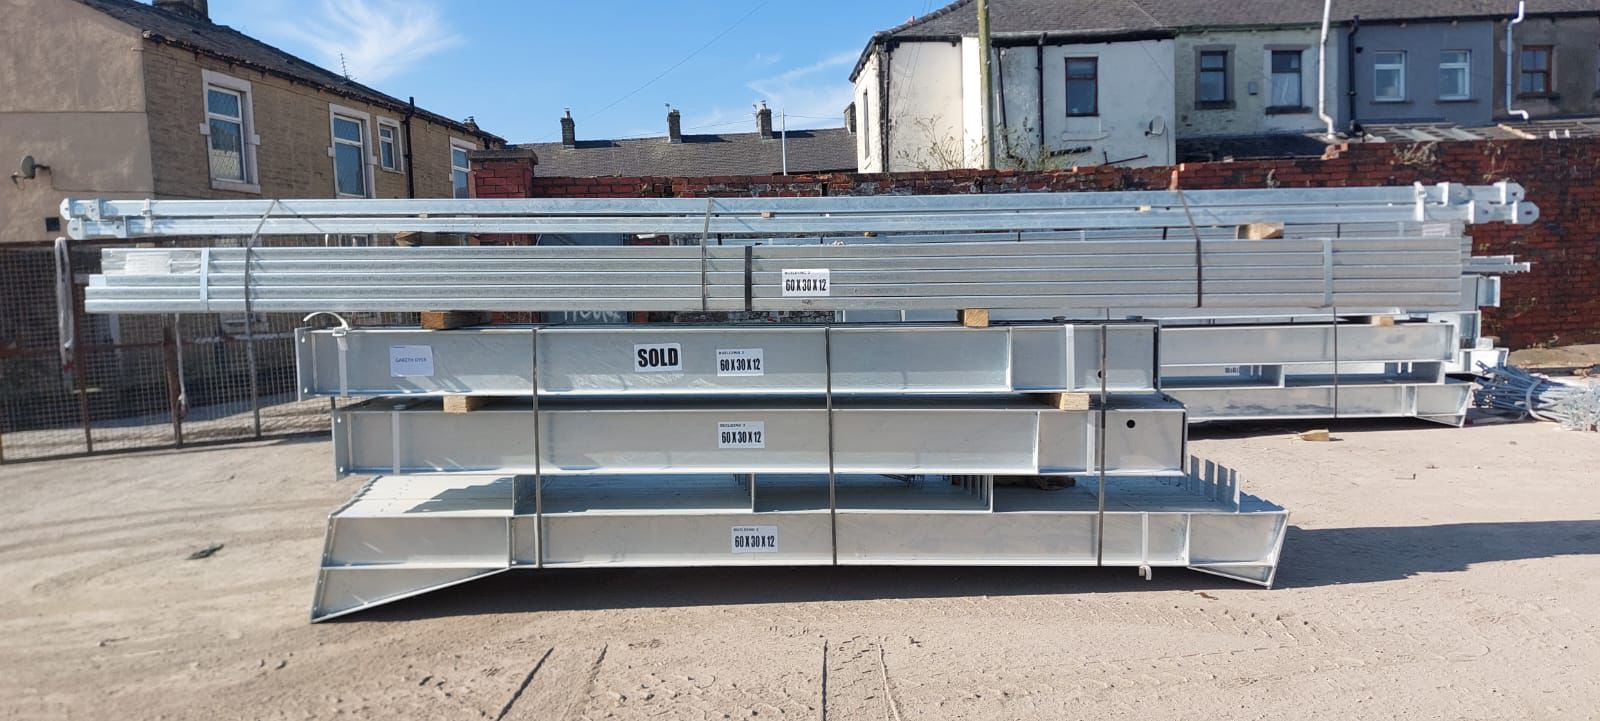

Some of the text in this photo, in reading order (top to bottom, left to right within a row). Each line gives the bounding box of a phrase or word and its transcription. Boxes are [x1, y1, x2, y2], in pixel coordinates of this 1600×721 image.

[786, 279, 794, 291] 60
[802, 279, 811, 291] 30
[819, 279, 826, 291] 12
[637, 348, 678, 368] SOLD
[720, 359, 729, 371] 60
[736, 358, 746, 370] 30
[753, 358, 760, 370] 12
[722, 432, 730, 443] 60
[738, 432, 747, 443] 30
[754, 431, 762, 442] 12
[734, 536, 744, 548] 60
[751, 536, 760, 548] 30
[767, 536, 774, 548] 12
